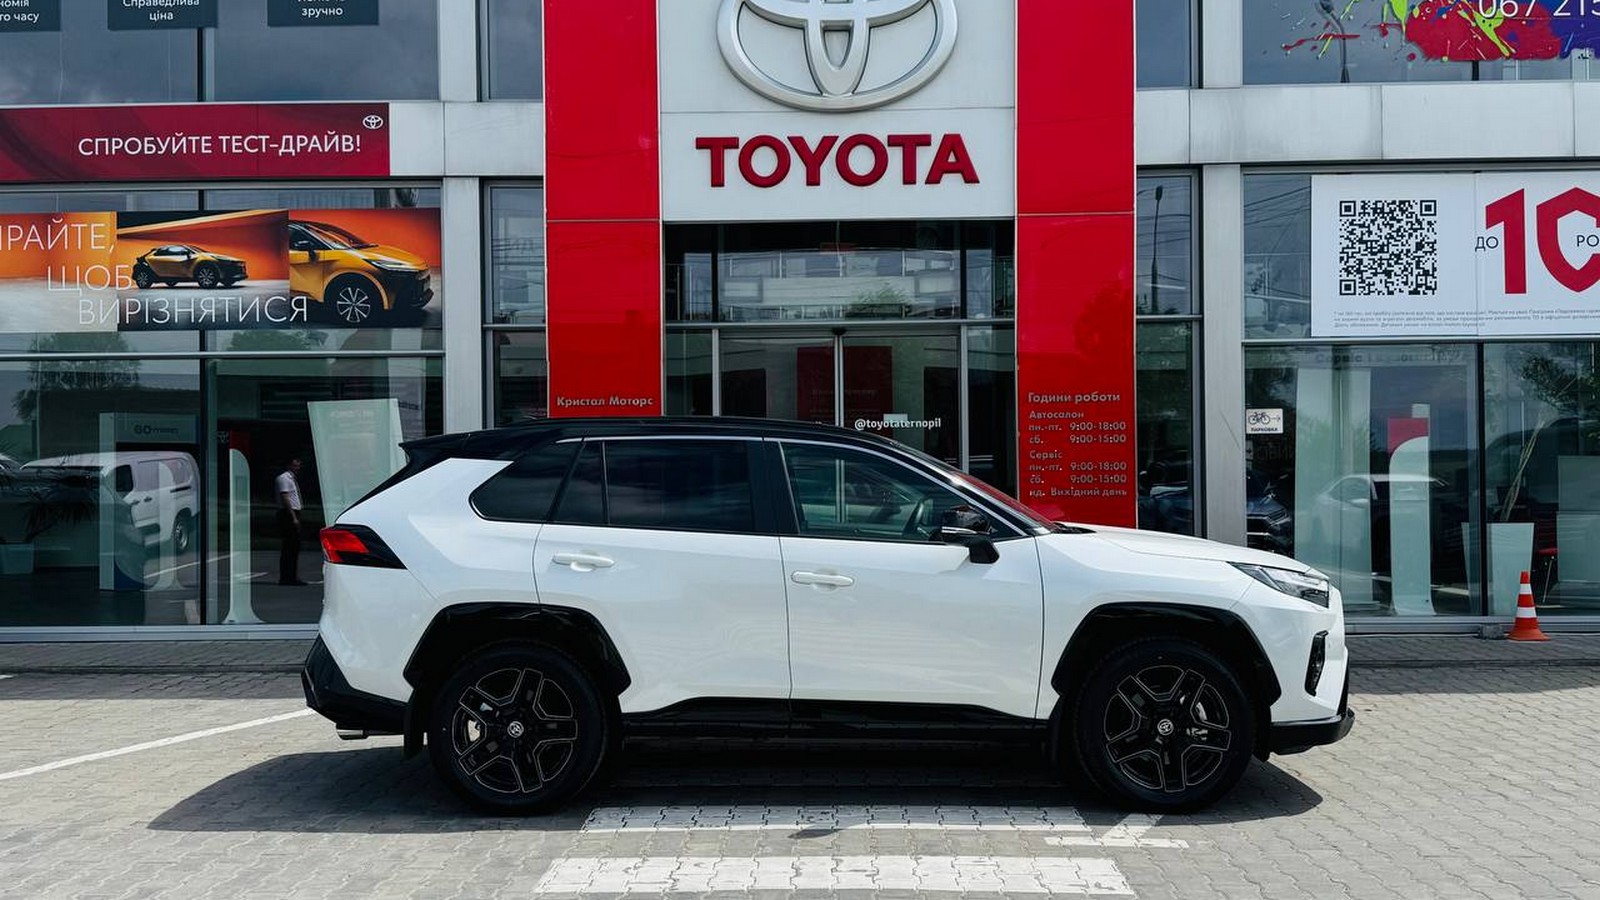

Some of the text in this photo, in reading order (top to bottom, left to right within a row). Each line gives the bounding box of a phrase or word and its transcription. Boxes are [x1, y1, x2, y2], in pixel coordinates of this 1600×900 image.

[122, 0, 200, 9] Справедлива
[13, 13, 40, 24] часу
[149, 10, 174, 22] ціна
[301, 7, 344, 18] зручно
[77, 130, 362, 156] СПРОБУЙТЕ ТЕСТ-ДРАЙВ!
[695, 133, 981, 189] TOYOTA
[0, 217, 115, 254] РАЙТЕ,
[1485, 186, 1600, 294] 10
[1475, 235, 1500, 252] ДО
[47, 264, 132, 297] ЩОБ
[78, 296, 308, 326] ВИРІЗНЯТИСЯ
[557, 395, 654, 408] Кристал Моторс
[1028, 392, 1119, 403] Години роботи
[1029, 410, 1084, 419] Автосалон
[854, 417, 942, 431] @toyotaternopil
[1029, 434, 1045, 444] сб.
[1029, 449, 1063, 460] Сервіс
[1050, 486, 1100, 498] Вихідний
[1102, 489, 1127, 498] день
